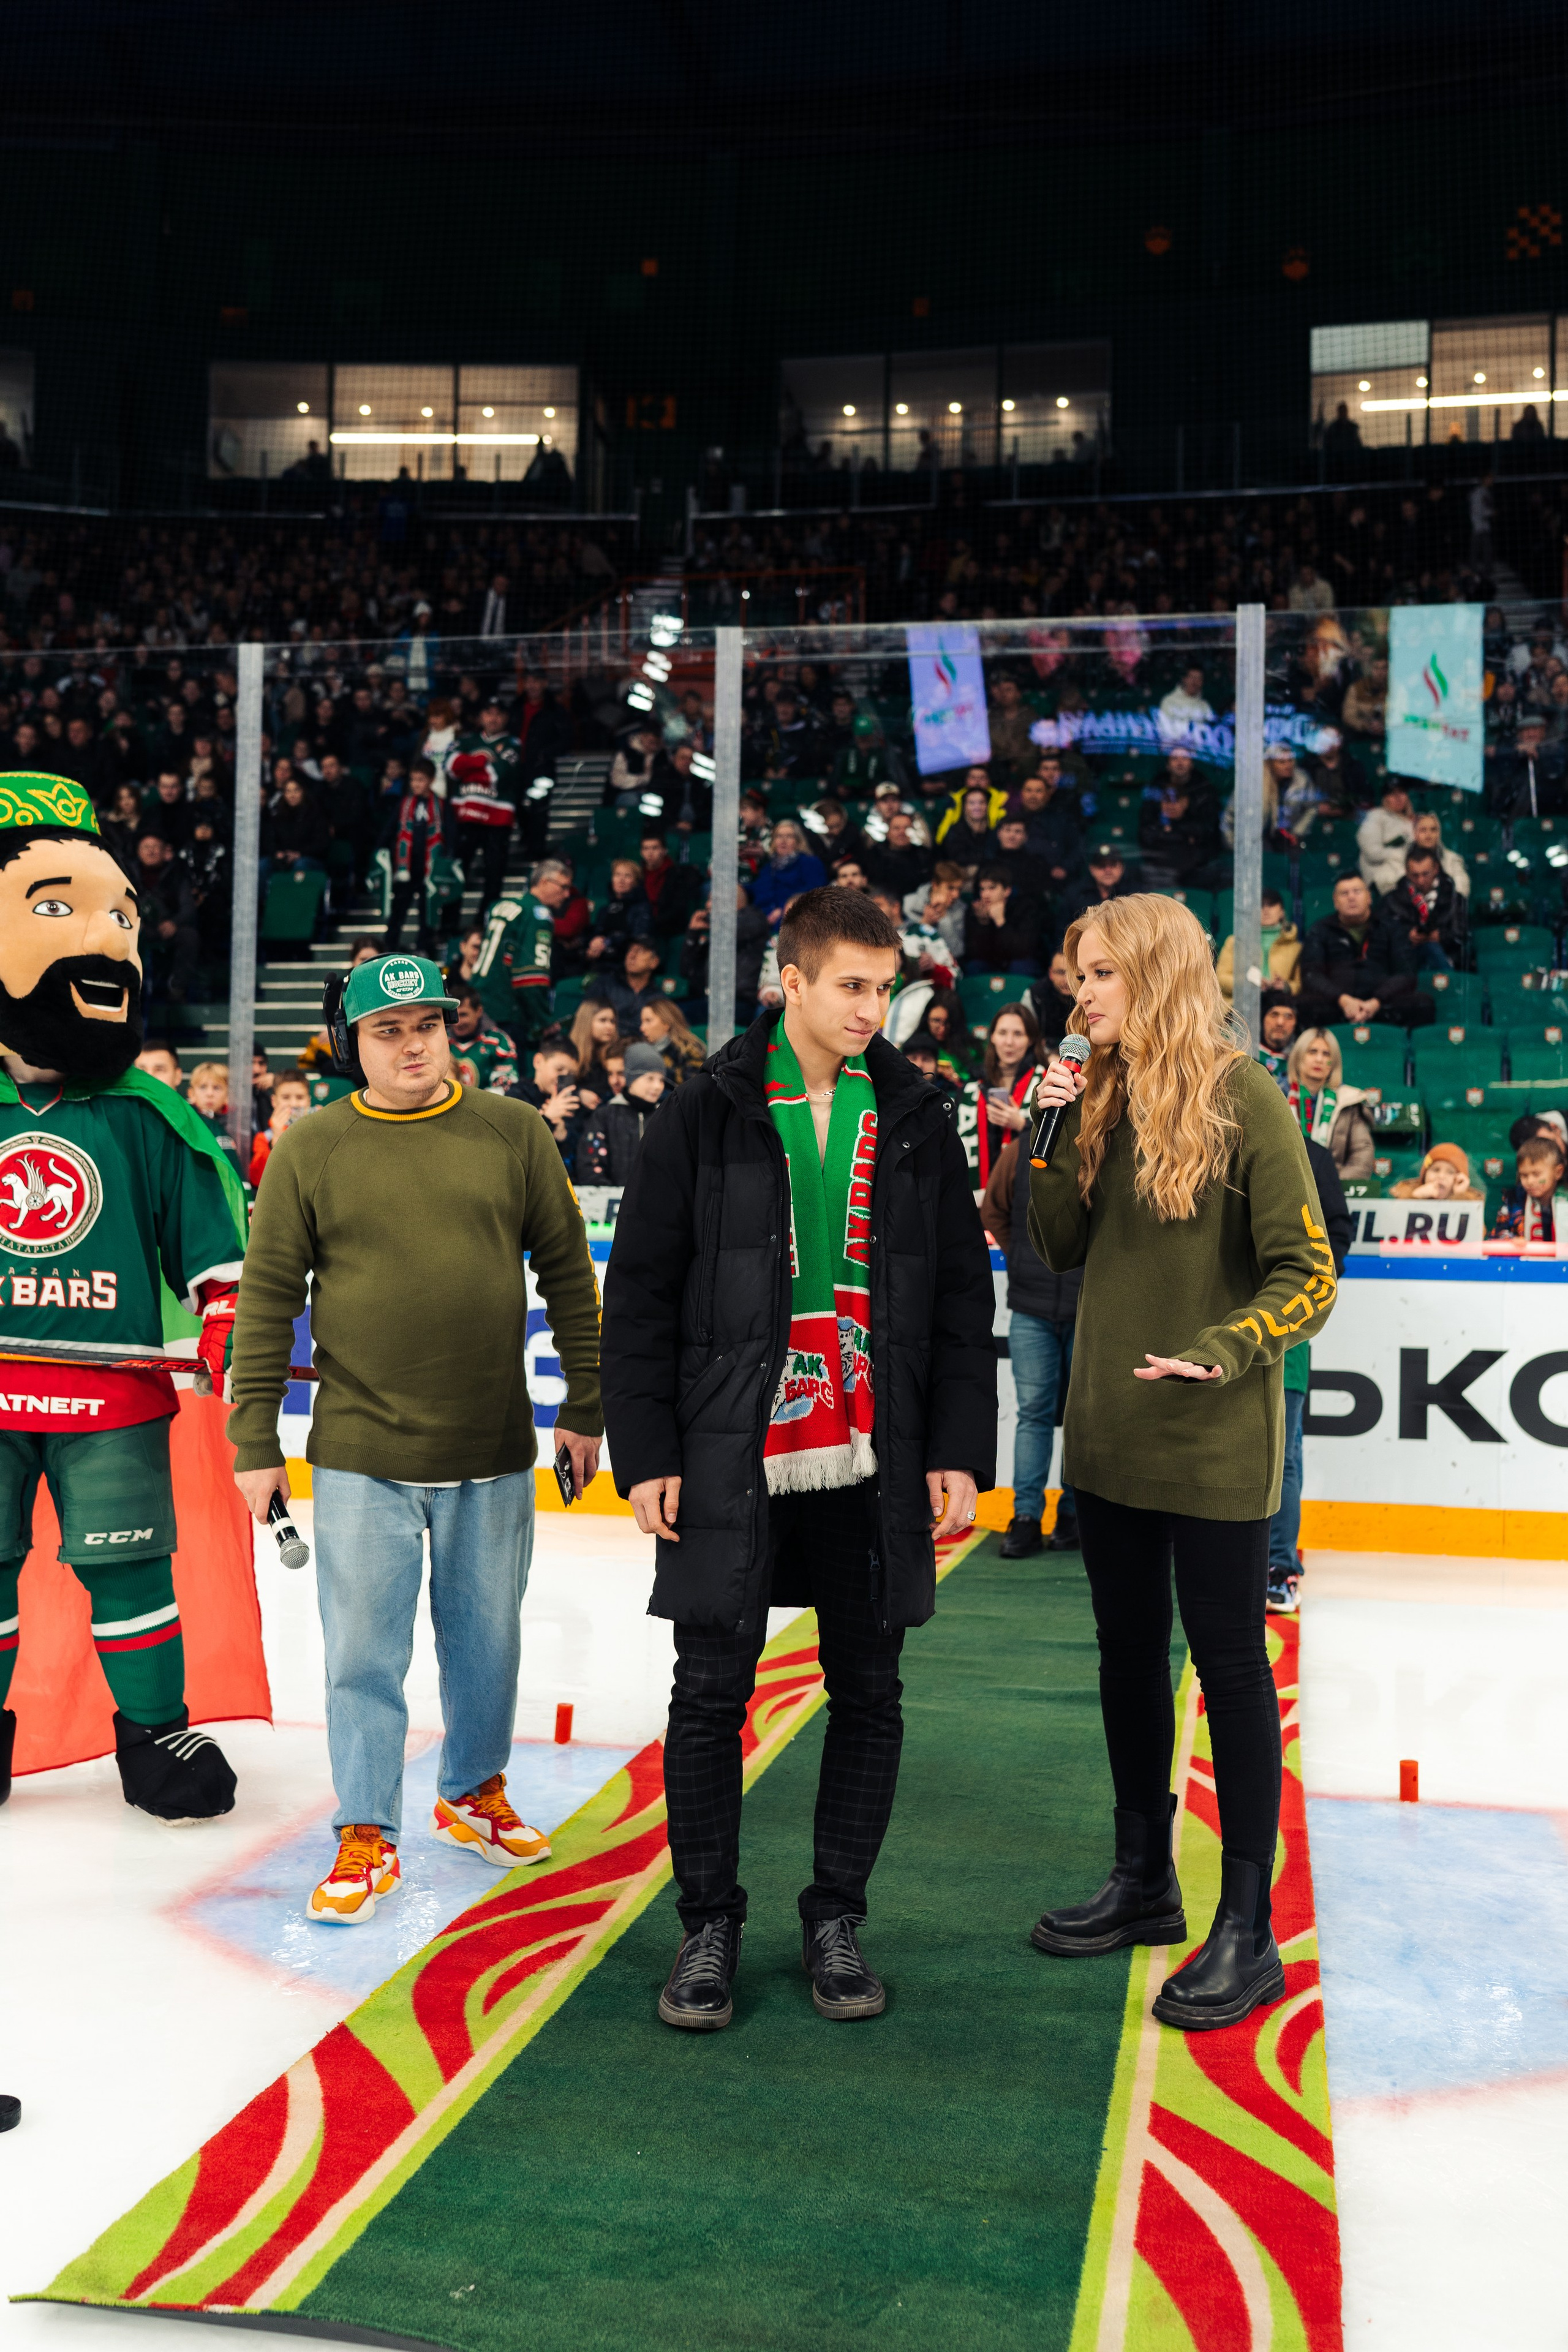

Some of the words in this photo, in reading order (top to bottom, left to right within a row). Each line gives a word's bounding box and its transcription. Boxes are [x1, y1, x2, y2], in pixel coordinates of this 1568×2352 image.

[385, 973, 396, 982] AK
[398, 971, 420, 979] BARS
[387, 979, 418, 990] HOCKEY
[1350, 1210, 1469, 1246] L.RU
[11, 1270, 117, 1311] BARS
[793, 1353, 823, 1379] АК
[785, 1377, 834, 1409] БАРС
[85, 1528, 153, 1545] CCM
